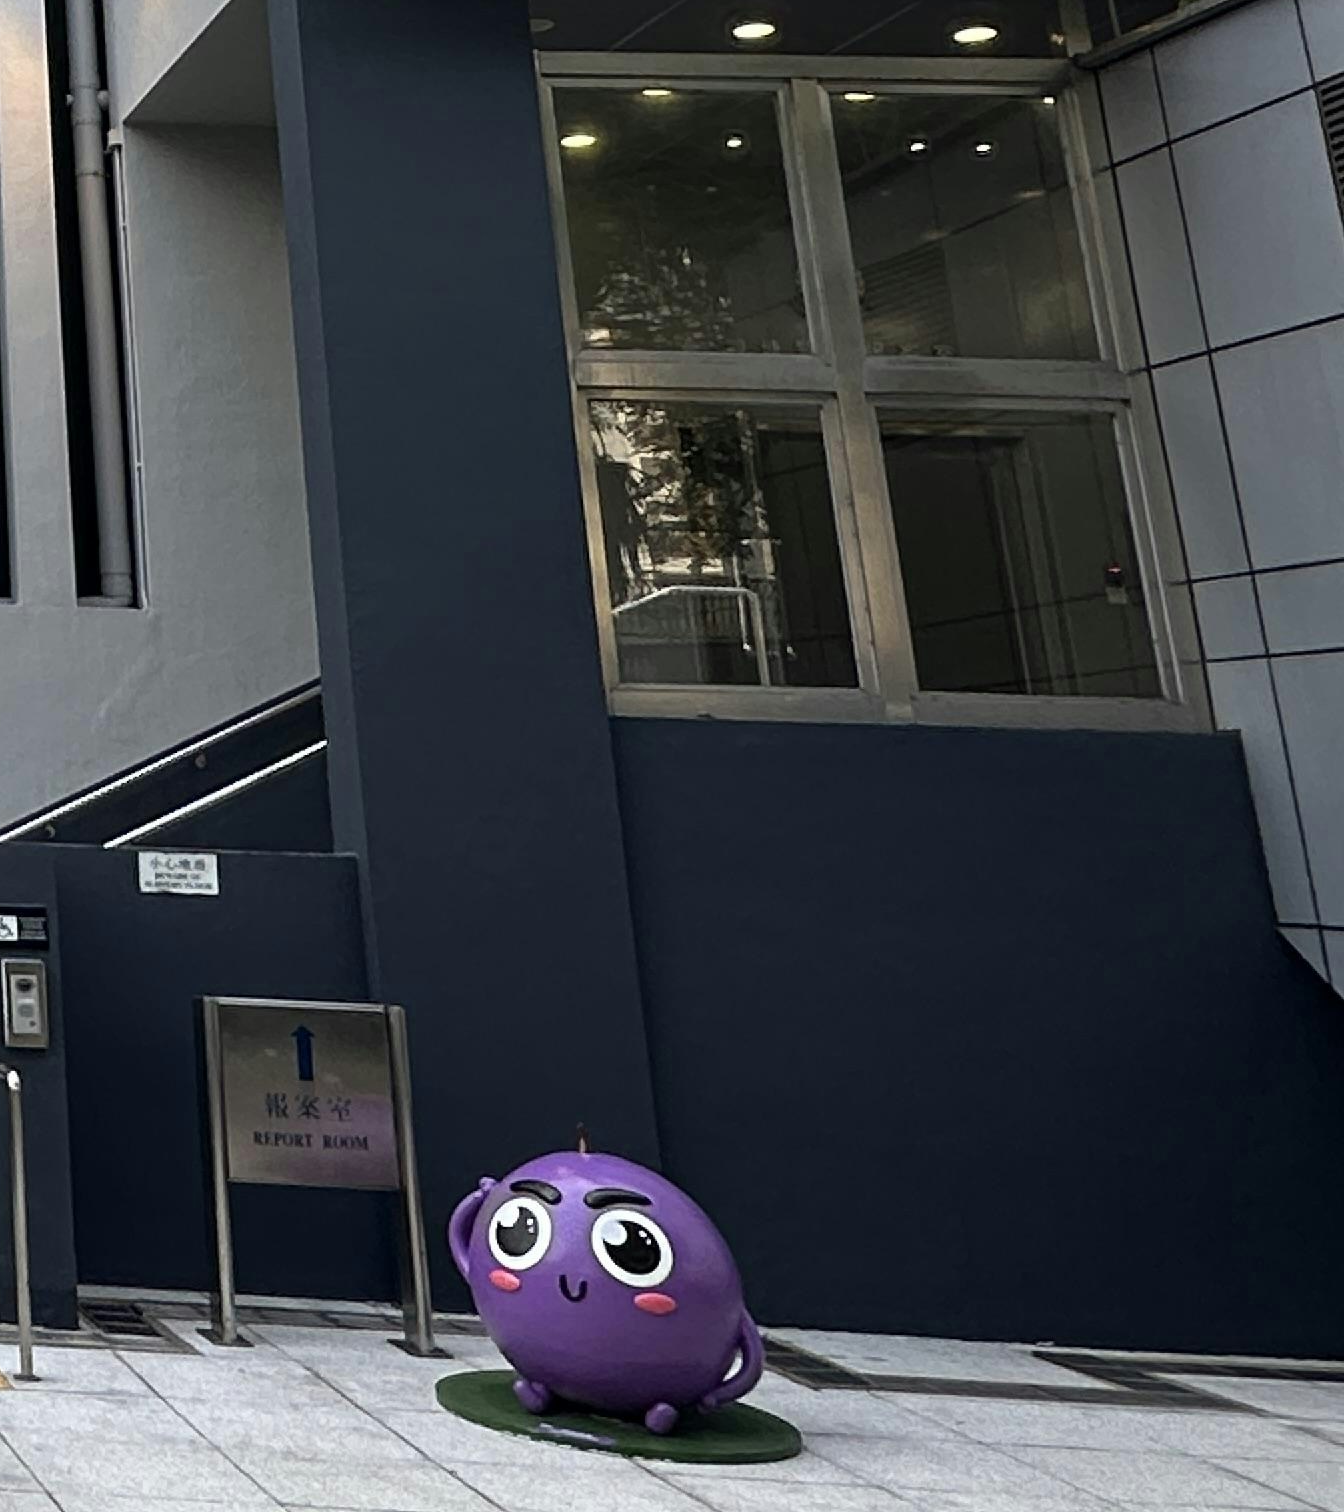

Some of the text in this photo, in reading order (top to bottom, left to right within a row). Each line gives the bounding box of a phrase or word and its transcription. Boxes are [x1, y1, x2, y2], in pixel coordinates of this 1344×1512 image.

[264, 1092, 353, 1122] 報案室
[253, 1131, 370, 1151] REPORT ROOM
